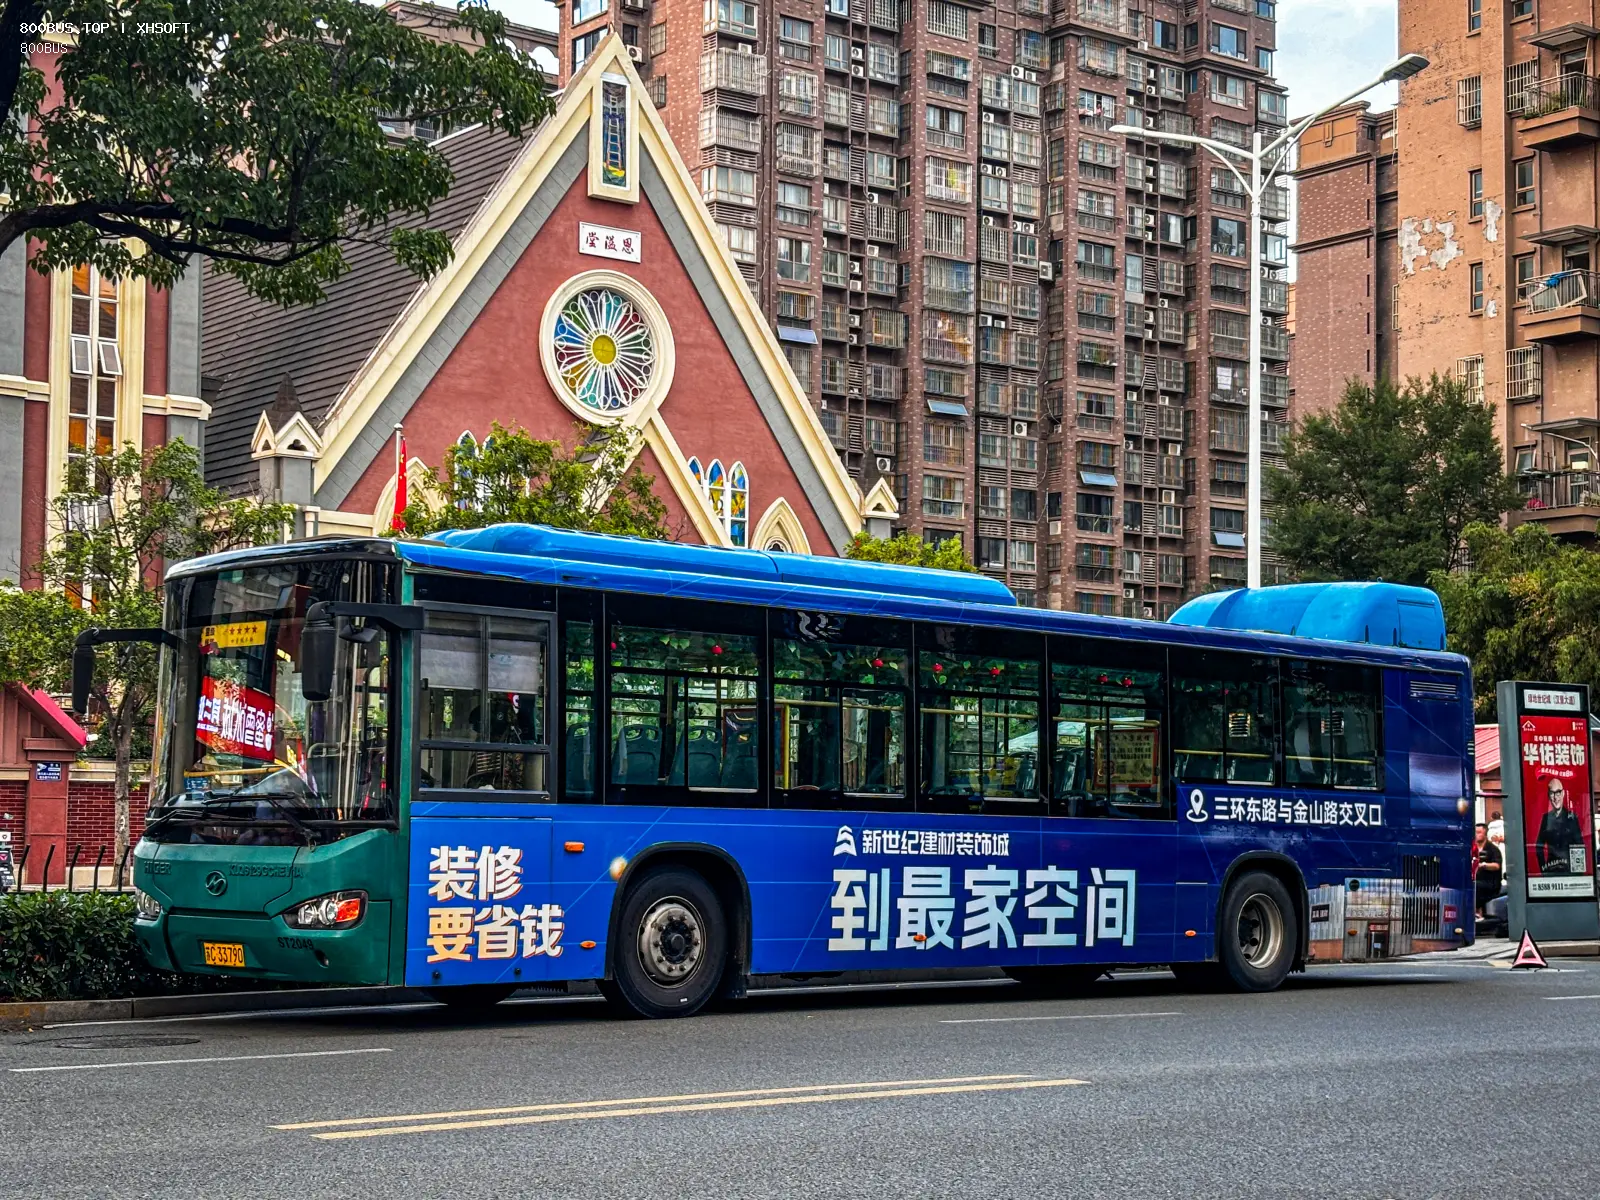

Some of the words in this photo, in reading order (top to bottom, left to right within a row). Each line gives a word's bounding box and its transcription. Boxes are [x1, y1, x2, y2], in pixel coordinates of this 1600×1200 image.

[1523, 742, 1585, 766] 华佑装饰
[1213, 796, 1382, 827] 三环东路与金山路交叉口
[862, 829, 1010, 857] 新世纪建材装饰城
[428, 845, 524, 901] 装修
[828, 864, 1137, 951] 到最家空间
[426, 903, 565, 963] 要省钱
